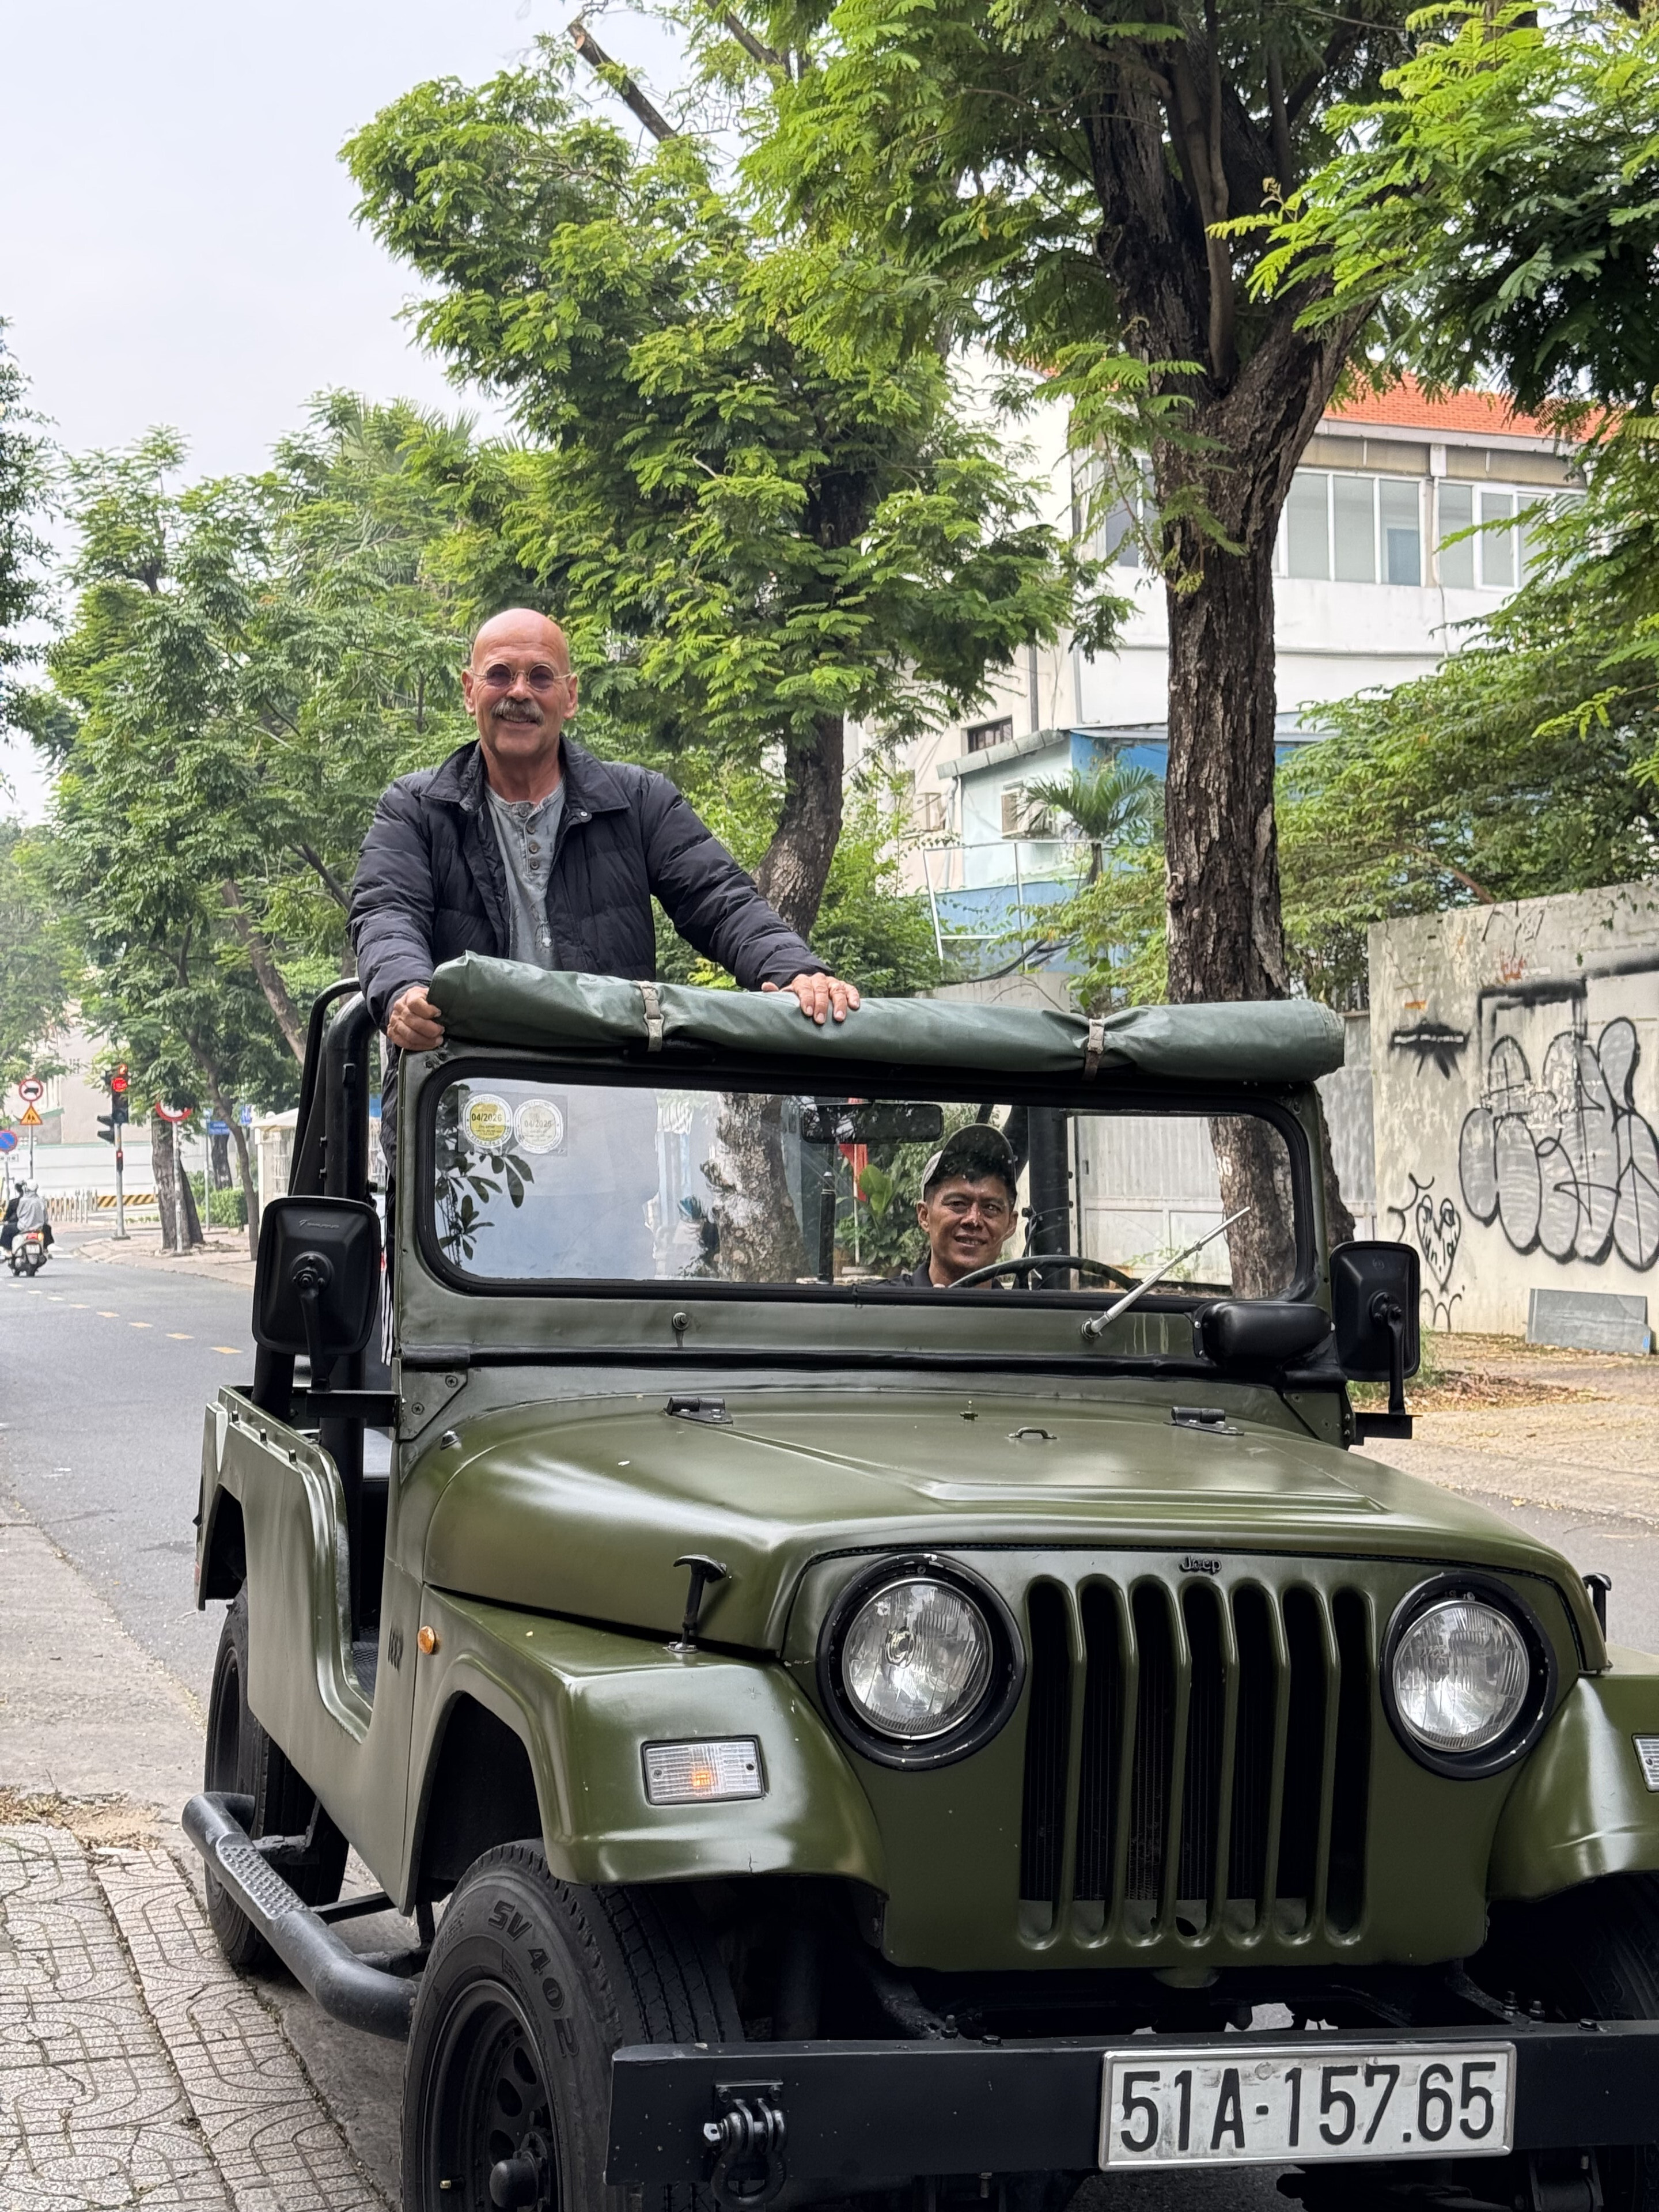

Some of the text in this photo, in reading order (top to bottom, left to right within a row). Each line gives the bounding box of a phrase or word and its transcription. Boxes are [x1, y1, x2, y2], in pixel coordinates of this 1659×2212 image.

[471, 1113, 502, 1122] 04/2026
[1179, 1555, 1222, 1575] Jeep
[488, 1900, 533, 1942] SV
[527, 1948, 580, 2058] 402
[1120, 2061, 1497, 2153] 51A-157.65
